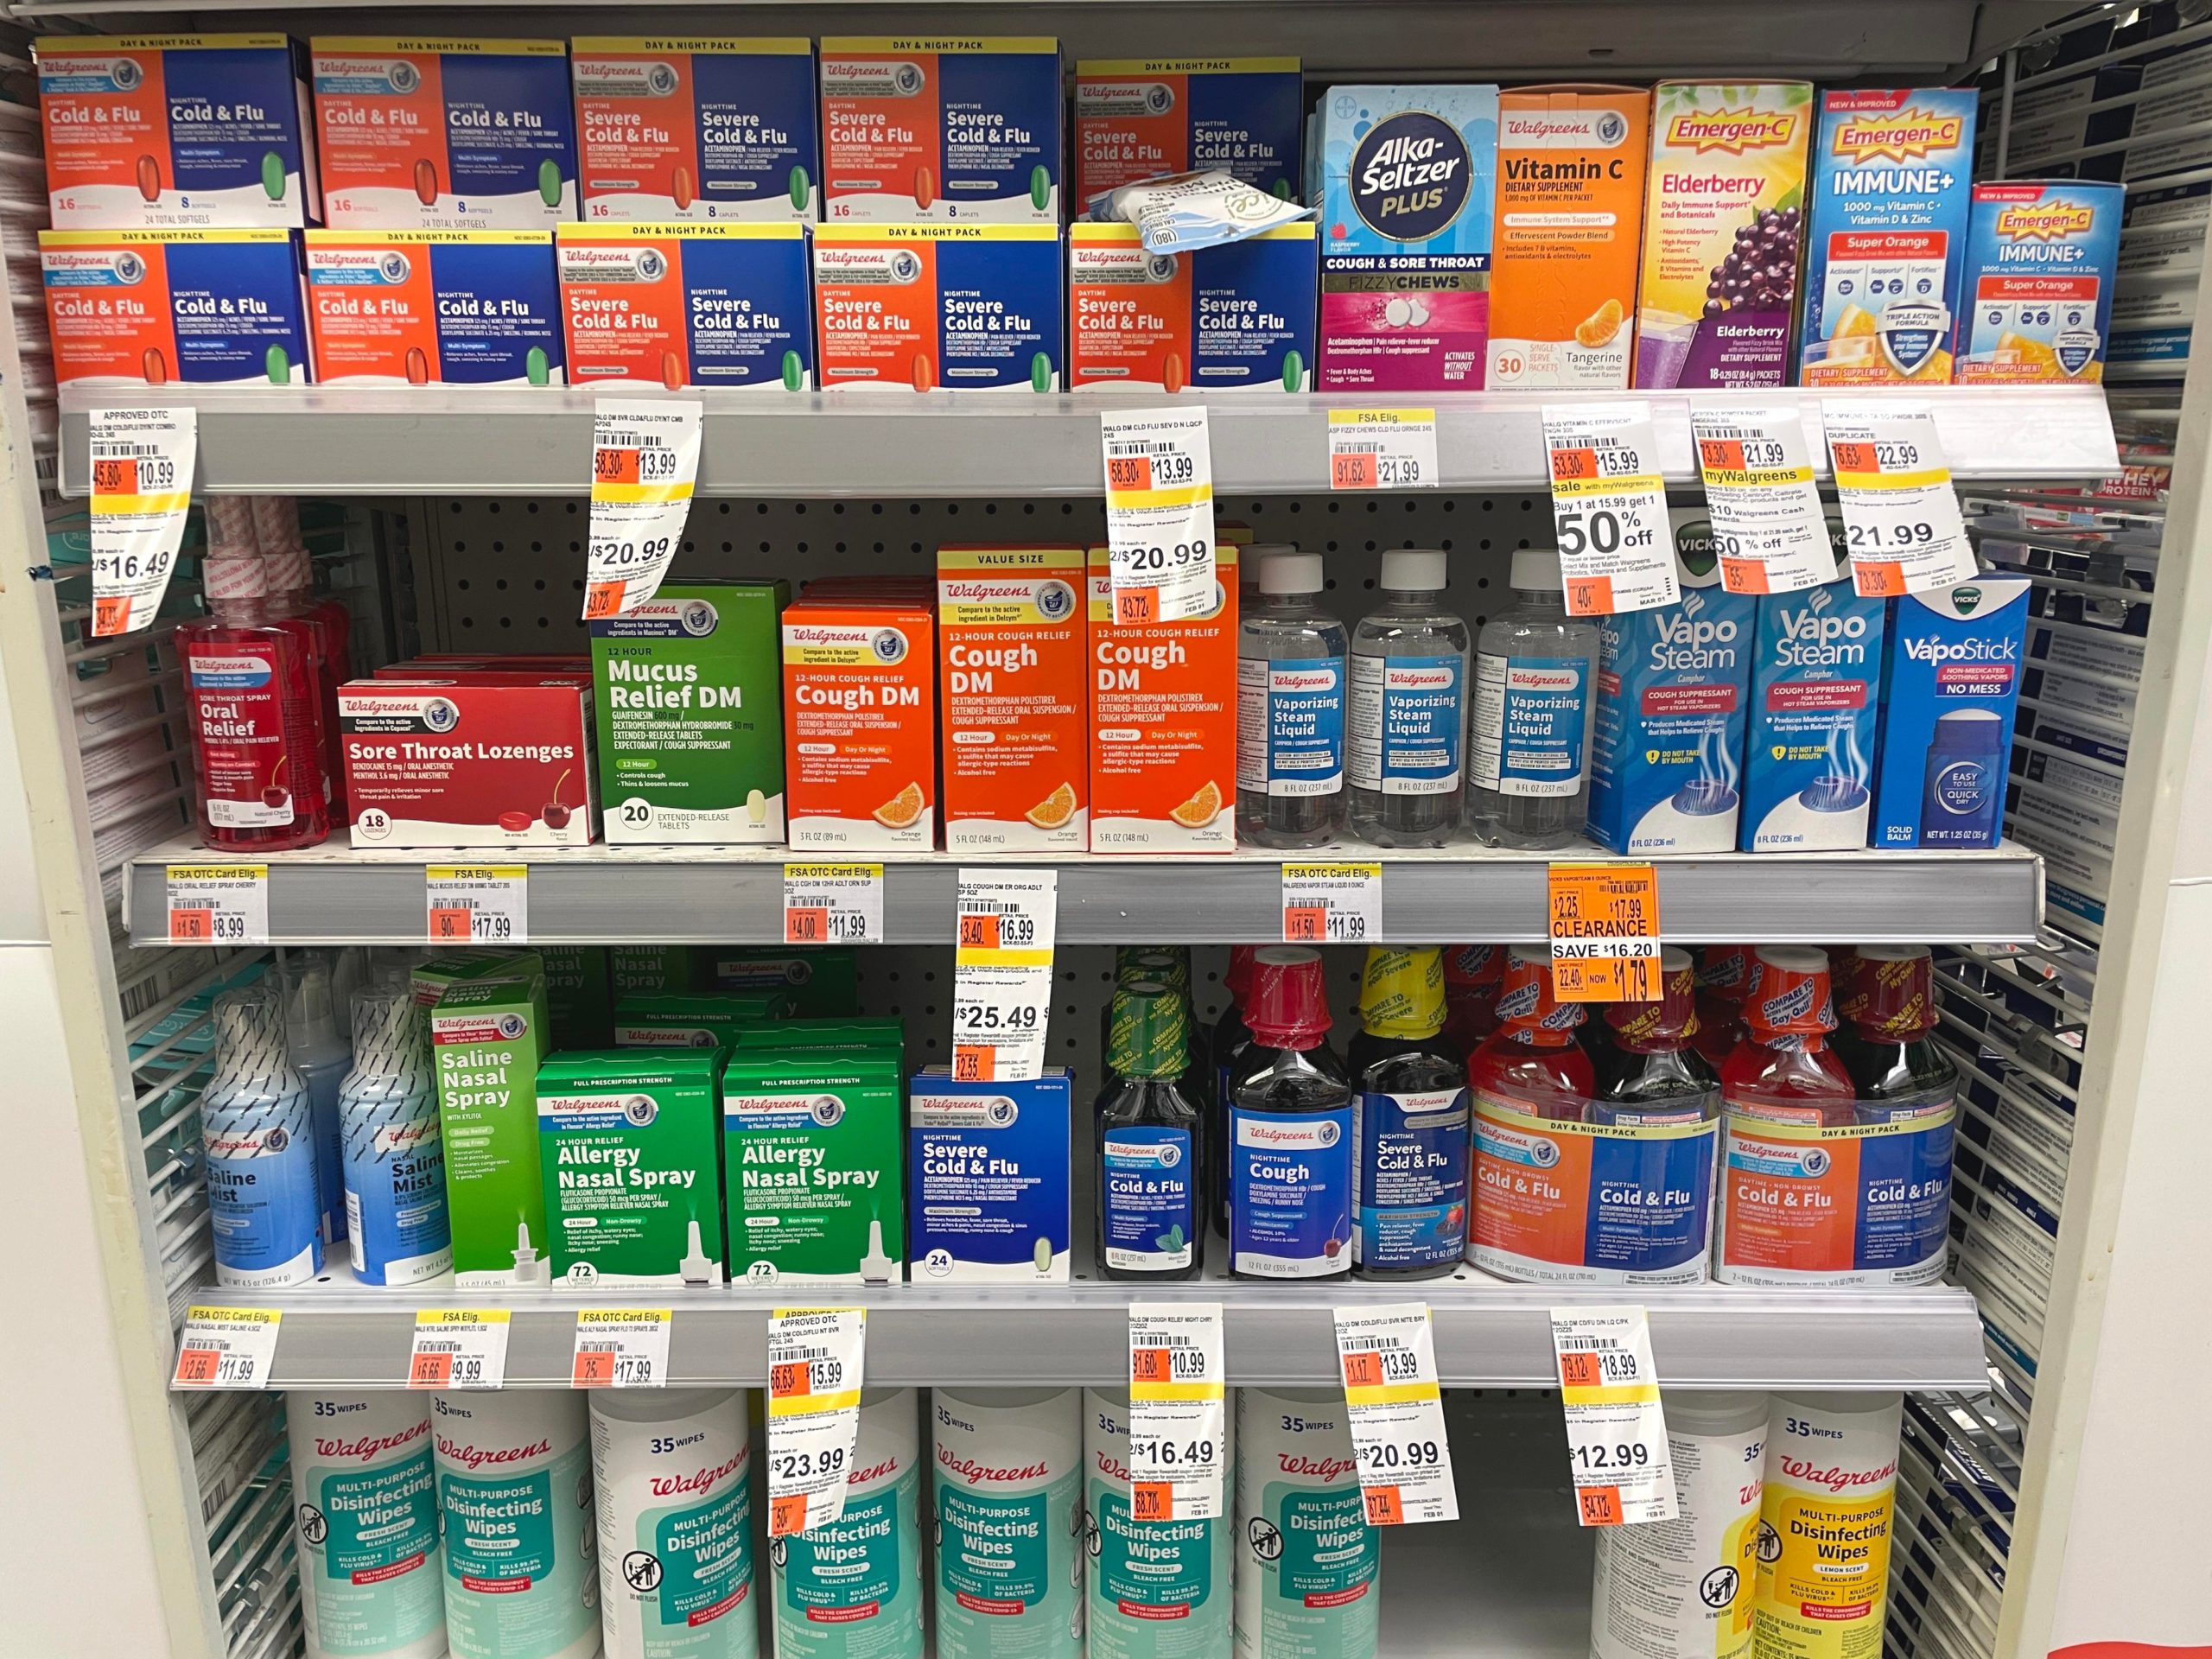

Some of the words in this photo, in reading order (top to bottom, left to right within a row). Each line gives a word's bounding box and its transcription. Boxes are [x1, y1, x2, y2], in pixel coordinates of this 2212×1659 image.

[645, 41, 663, 50] DAY
[666, 41, 674, 50] &
[677, 41, 706, 50] NIGHT
[709, 41, 735, 50] PACK
[172, 105, 213, 122] Cold
[217, 106, 232, 121] &
[236, 105, 264, 121] Flu
[1509, 121, 1590, 138] Walgreens
[1676, 119, 1789, 141] Emergen-C
[1842, 123, 1955, 149] Emergen-C
[1361, 154, 1459, 195] Seltzer
[1505, 159, 1601, 180] Vitamin
[1609, 160, 1624, 179] C
[1505, 182, 1535, 192] DIETARY
[1538, 181, 1583, 191] SUPPLEMENT
[1662, 175, 1765, 197] Elderberry
[1834, 169, 1955, 195] IMMUNE+
[1382, 191, 1442, 217] PLUS
[146, 215, 156, 224] 24
[159, 215, 175, 224] TOTAL
[1851, 215, 1889, 225] Vitamin
[1891, 215, 1899, 224] D
[1902, 215, 1908, 224] &
[1911, 214, 1932, 224] Zinc
[1847, 237, 1883, 249] Super
[1886, 236, 1929, 248] Orange
[1326, 257, 1375, 270] COUGH
[1378, 257, 1387, 269] &
[1390, 257, 1426, 269] SORE
[1429, 257, 1484, 268] THROAT
[945, 299, 1003, 315] Severe
[945, 315, 984, 331] Cold
[988, 315, 1002, 331] &
[1006, 315, 1031, 331] Flu
[1717, 326, 1784, 339] Elderberry
[1498, 359, 1521, 372] 30
[1567, 353, 1623, 365] Tangerine
[104, 411, 149, 420] APPROVED
[151, 410, 168, 419] OTC
[1358, 413, 1377, 423] FSA
[1381, 412, 1401, 423] Elig.
[1595, 451, 1640, 474] $15.99
[1740, 443, 1783, 464] $21.99
[1873, 445, 1918, 467] $22.99
[134, 461, 174, 484] $10.99
[636, 453, 676, 474] $13.99
[1151, 457, 1192, 480] $13.99
[1378, 461, 1419, 482] $21.99
[1706, 469, 1797, 485] myWalgreens
[1553, 480, 1580, 493] sale
[1602, 480, 1654, 490] myWalgreens
[1554, 501, 1573, 512] Buy
[1577, 501, 1581, 510] 1
[1599, 499, 1626, 508] 15.99
[1630, 497, 1647, 506] get
[1558, 512, 1620, 555] 50
[1621, 512, 1641, 528] %
[1624, 531, 1652, 547] off
[978, 555, 1015, 563] VALUE
[1020, 555, 1044, 563] SIZE
[1110, 540, 1207, 570] 2/$20.99
[947, 585, 1031, 603] Walgreens
[1780, 608, 1866, 644] Vapo
[793, 629, 868, 645] Walgreens
[997, 632, 1033, 640] COUGH
[1037, 632, 1071, 640] RELIEF
[1776, 642, 1864, 666] Steam
[1904, 637, 2016, 666] VapoStick
[608, 660, 697, 682] Mucus
[611, 686, 692, 708] Relief
[700, 687, 741, 708] DM
[795, 685, 874, 710] Cough
[881, 687, 919, 705] DM
[1946, 684, 1964, 695] NO
[1967, 684, 2001, 694] MESS
[201, 703, 238, 719] Oral
[1389, 696, 1456, 709] Vaporizing
[1389, 710, 1432, 721] Steam
[203, 721, 255, 736] Relief
[1389, 723, 1430, 736] Liquid
[349, 743, 397, 760] Sore
[402, 743, 474, 760] Throat
[478, 743, 574, 761] Lozenges
[1952, 773, 1978, 783] EASY
[1948, 791, 1978, 801] QUICK
[365, 815, 385, 828] 18
[624, 806, 649, 822] 20
[174, 870, 191, 879] FSA
[194, 869, 213, 878] OTC
[215, 869, 234, 878] Card
[236, 868, 257, 880] Elig.
[1610, 899, 1641, 918] $17.99
[213, 918, 244, 938] $8.99
[472, 918, 511, 938] $17.99
[995, 920, 1033, 940] $16.99
[1554, 920, 1647, 937] CLEARANCE
[1554, 944, 1599, 957] SAVE
[1604, 944, 1652, 957] $16.20
[442, 1051, 512, 1069] Saline
[444, 1069, 507, 1088] Nasal
[446, 1089, 511, 1111] Spray
[558, 1146, 640, 1167] Allergy
[924, 1143, 988, 1158] Severe
[924, 1160, 967, 1174] Cold
[970, 1160, 985, 1174] &
[989, 1160, 1018, 1174] Flu
[1250, 1163, 1309, 1184] Cough
[559, 1169, 624, 1188] Nasal
[629, 1169, 695, 1189] Spray
[931, 1255, 947, 1266] 24
[452, 1360, 480, 1381] $9.99
[1168, 1352, 1205, 1373] $10.99
[1379, 1352, 1417, 1375] $13.99
[1599, 1354, 1637, 1376] $18.99
[1786, 1417, 1810, 1437] 35
[1812, 1428, 1843, 1439] WIPES
[1569, 1443, 1648, 1469] $12.99
[1781, 1455, 1896, 1491] Walgreens
[1799, 1507, 1884, 1522] MULTI-PURPOSE
[1790, 1520, 1886, 1542] Disinfecting
[1817, 1543, 1869, 1561] Wipes
